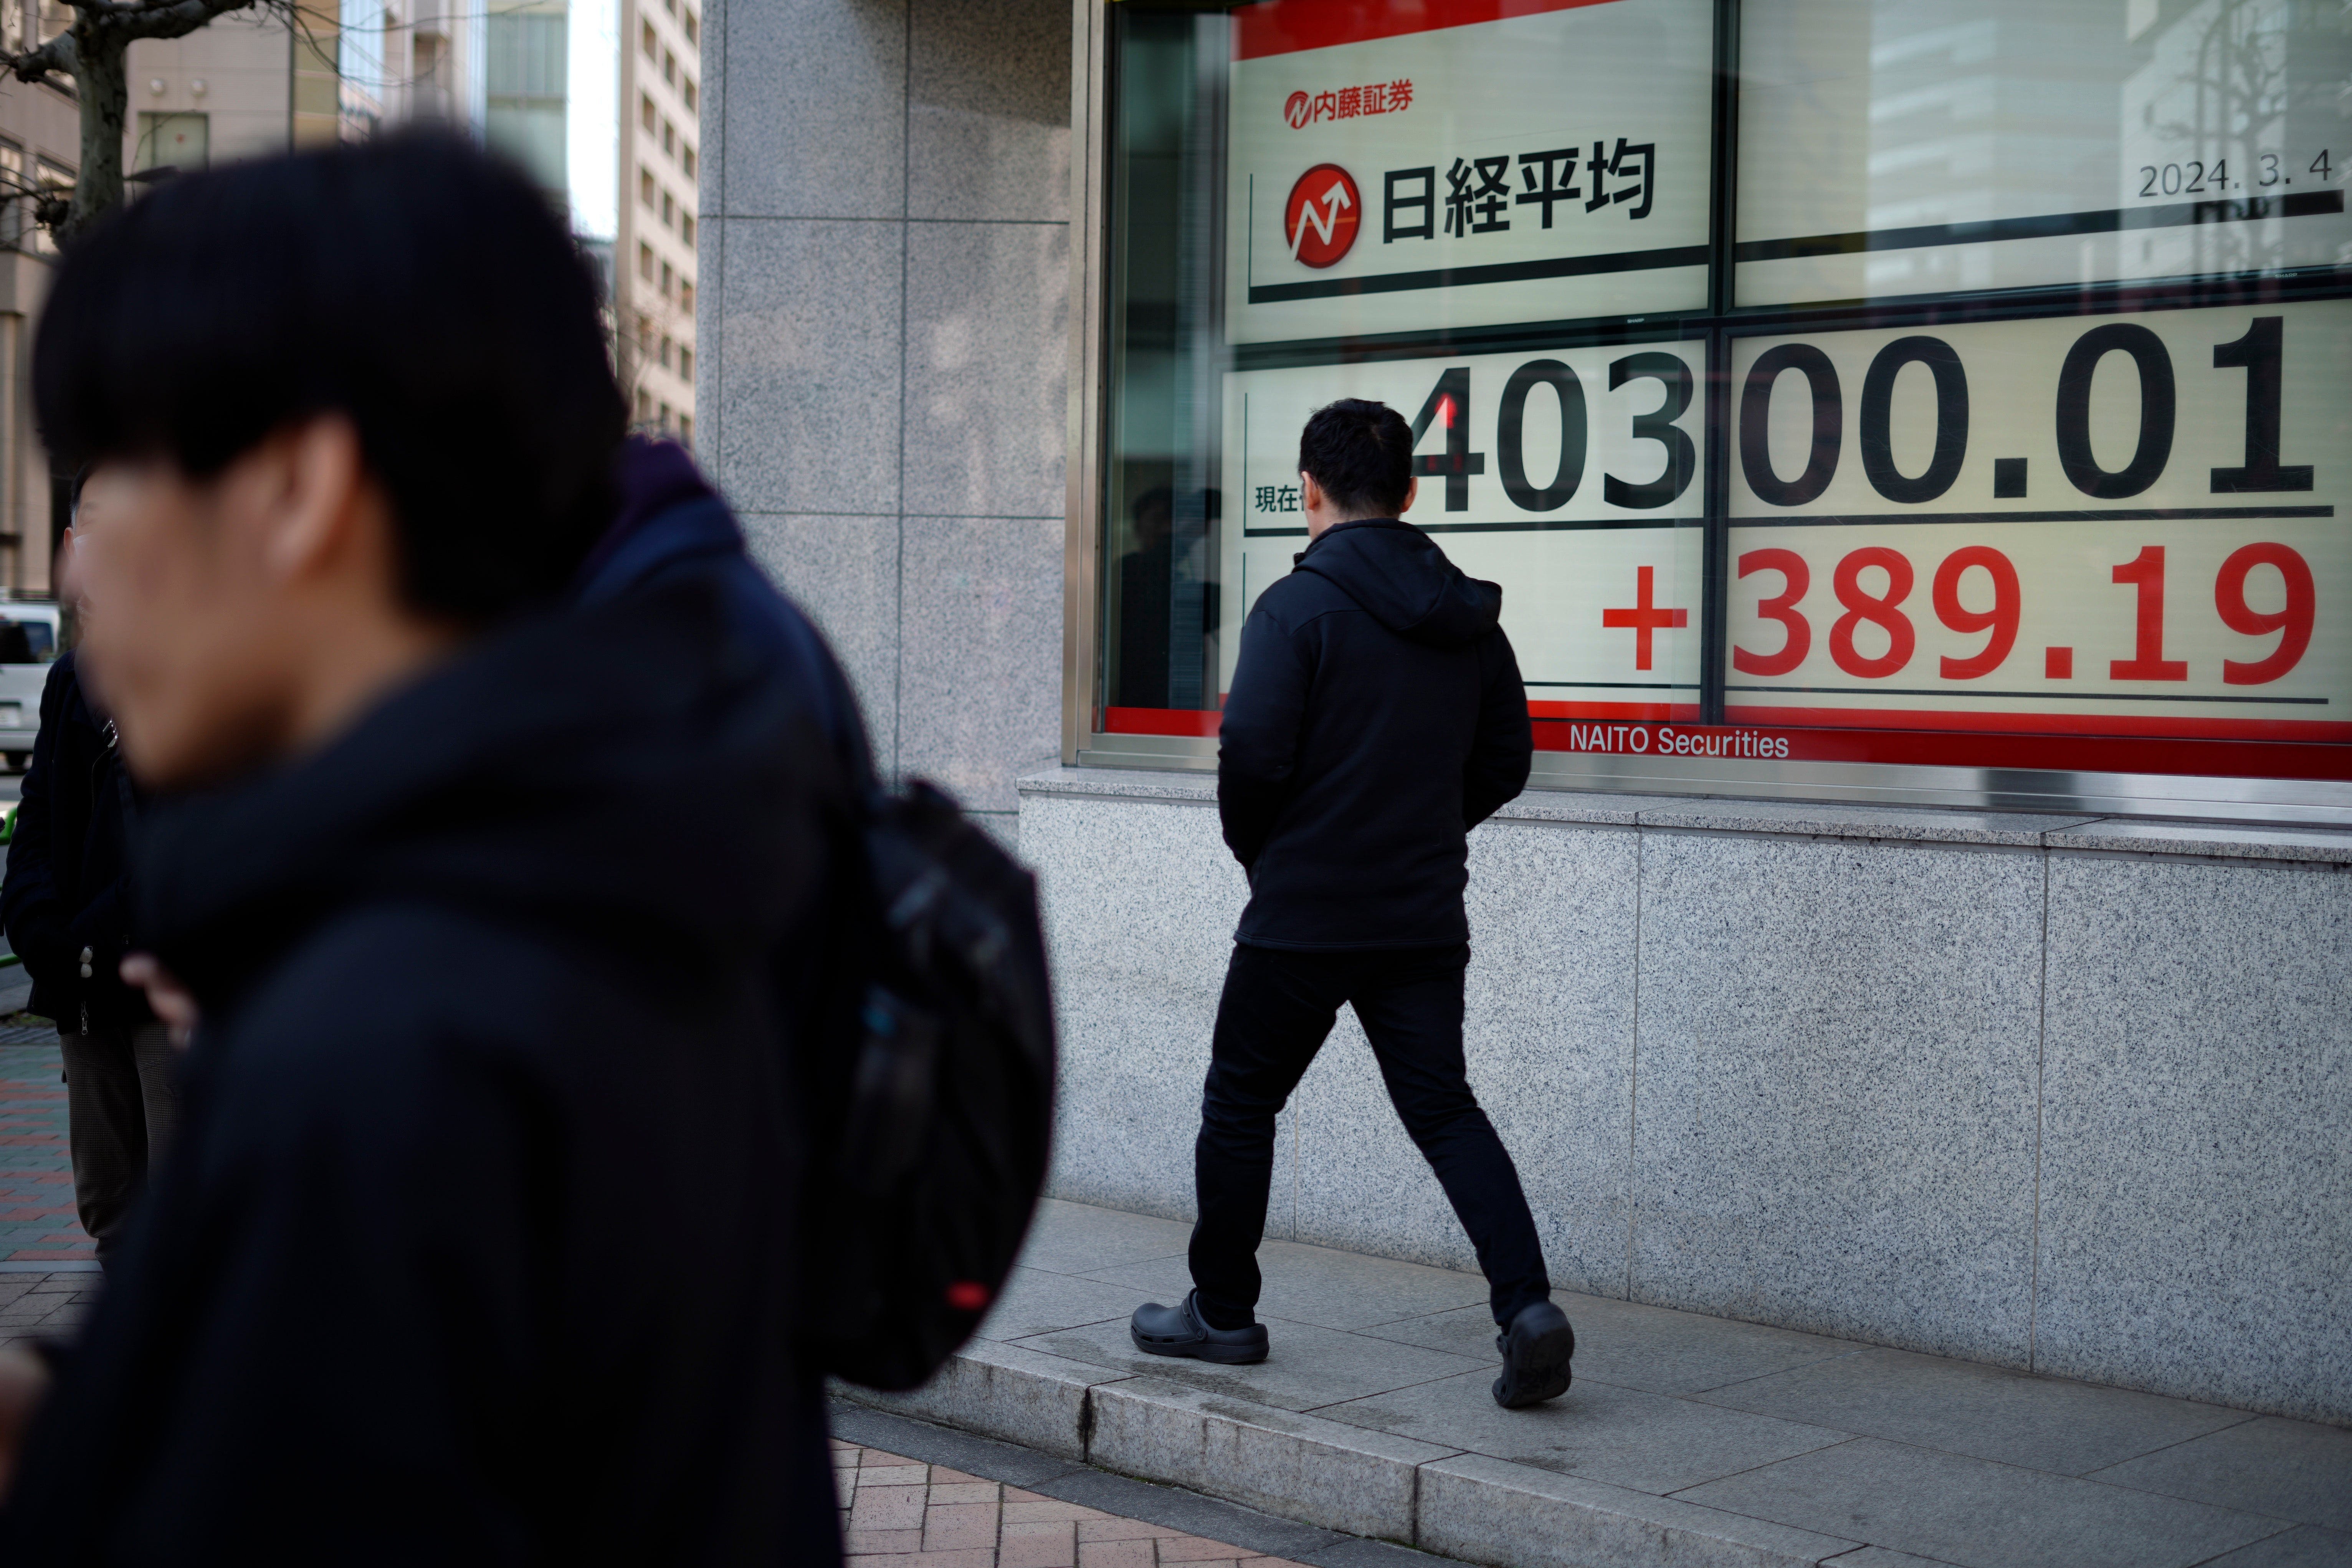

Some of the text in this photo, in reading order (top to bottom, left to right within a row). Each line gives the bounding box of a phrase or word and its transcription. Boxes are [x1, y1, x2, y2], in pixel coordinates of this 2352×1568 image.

[1314, 79, 1413, 123] 内藤証券
[1383, 137, 1655, 244] 日経平均
[2139, 159, 2240, 197] 2024.
[2309, 149, 2332, 181] 4
[1411, 316, 2314, 512] 40300.01
[1255, 484, 1304, 512] 現在
[1570, 724, 1789, 758] NAITO Securities
